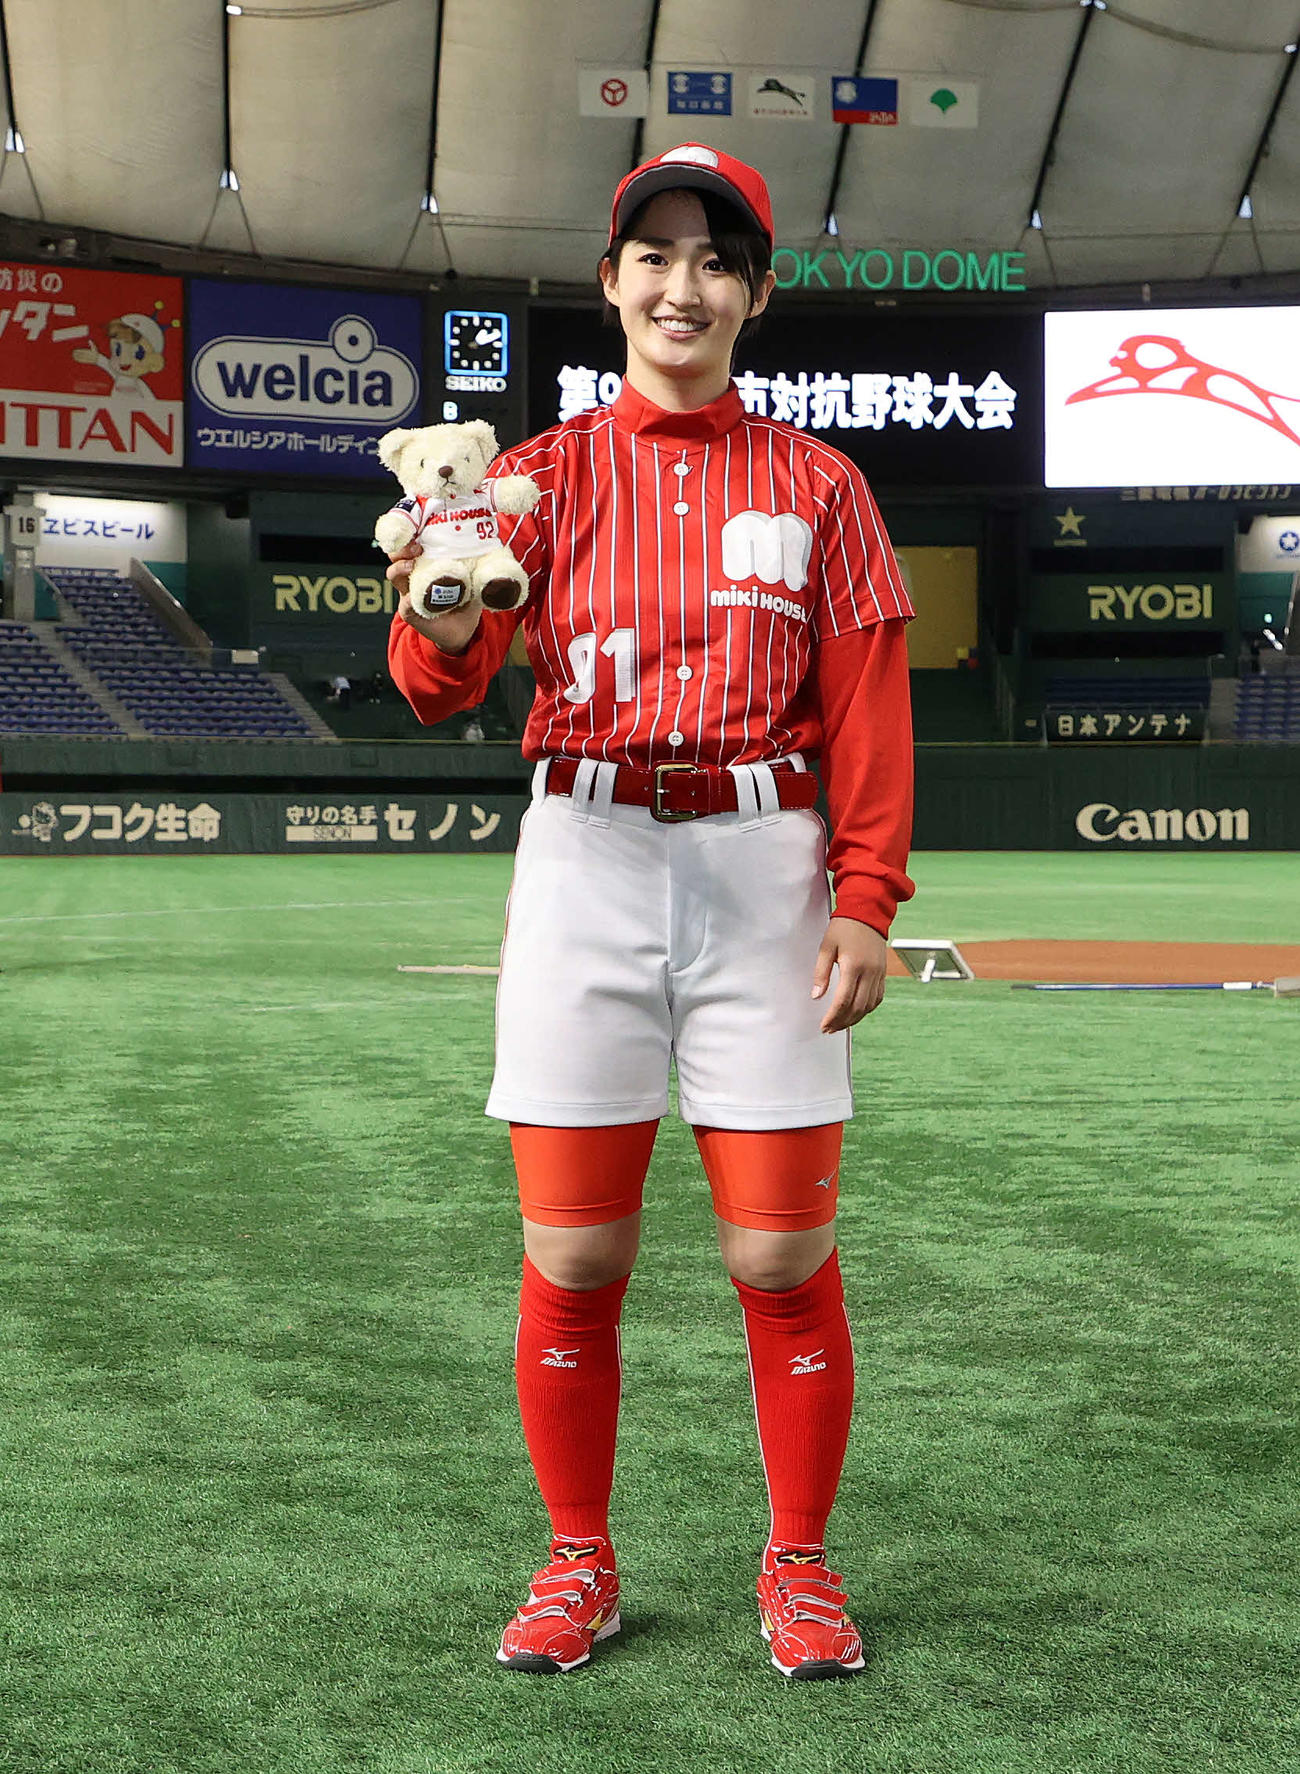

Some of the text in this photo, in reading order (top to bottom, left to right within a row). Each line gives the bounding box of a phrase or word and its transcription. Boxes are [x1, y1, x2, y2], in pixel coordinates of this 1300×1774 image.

[771, 248, 1026, 291] OKYO DOME
[217, 353, 393, 407] welcia
[445, 375, 507, 392] SEIKO
[476, 520, 495, 540] 92
[273, 574, 394, 614] RYOBI
[1088, 584, 1213, 620] RYOBI
[563, 628, 636, 704] 91
[1057, 713, 1192, 737] 日本アンテナ
[60, 802, 221, 843] フコク生命
[286, 804, 378, 825] 守りの名手
[383, 803, 501, 841] セノン
[1075, 803, 1250, 842] Canon
